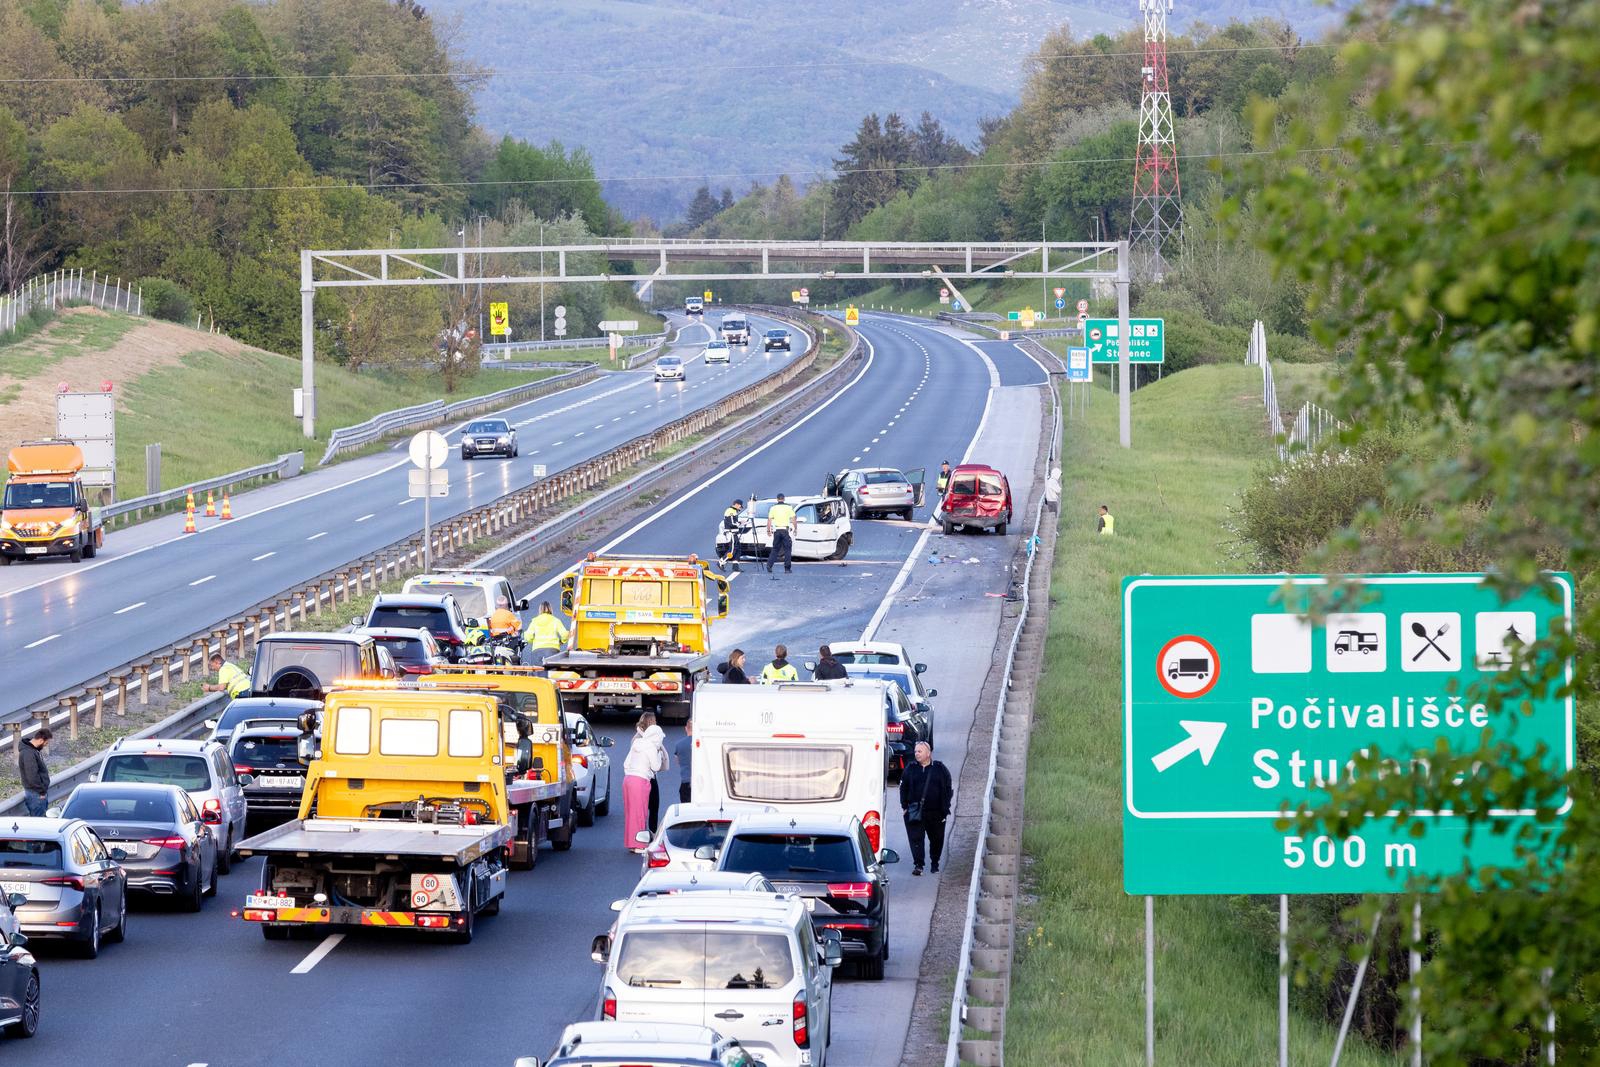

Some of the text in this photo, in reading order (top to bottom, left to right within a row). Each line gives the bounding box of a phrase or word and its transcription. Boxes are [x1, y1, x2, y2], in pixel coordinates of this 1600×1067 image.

[760, 711, 774, 725] 100
[1251, 696, 1489, 729] Počivališče
[1283, 835, 1417, 868] 500 m
[425, 879, 436, 888] 80
[253, 898, 263, 906] KP
[416, 895, 426, 903] 90
